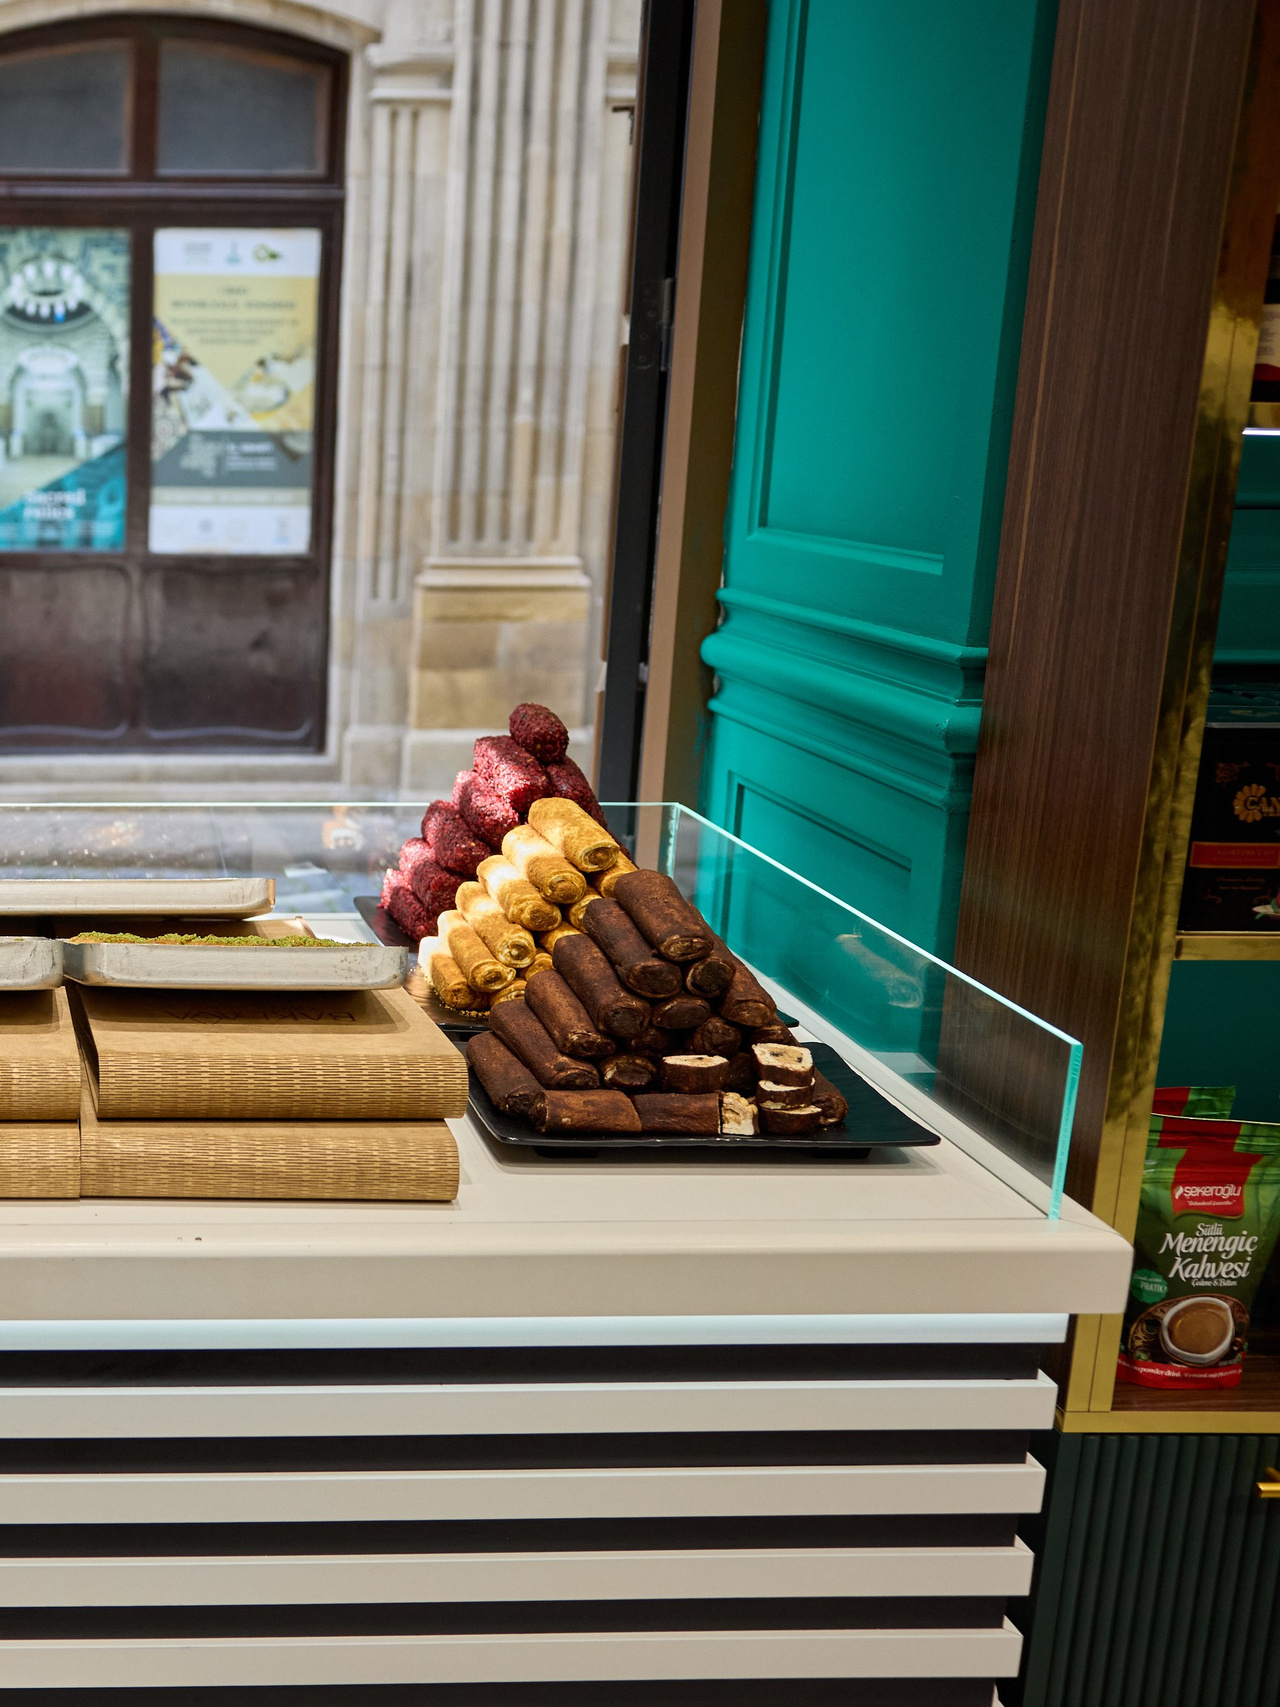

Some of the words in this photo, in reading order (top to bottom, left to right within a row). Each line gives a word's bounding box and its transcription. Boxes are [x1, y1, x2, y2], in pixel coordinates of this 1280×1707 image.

[1184, 1184, 1242, 1199] şekeroğlu
[1196, 1223, 1223, 1237] Sütlü
[1159, 1231, 1258, 1259] Menengiç
[1168, 1255, 1251, 1282] Kahvesi
